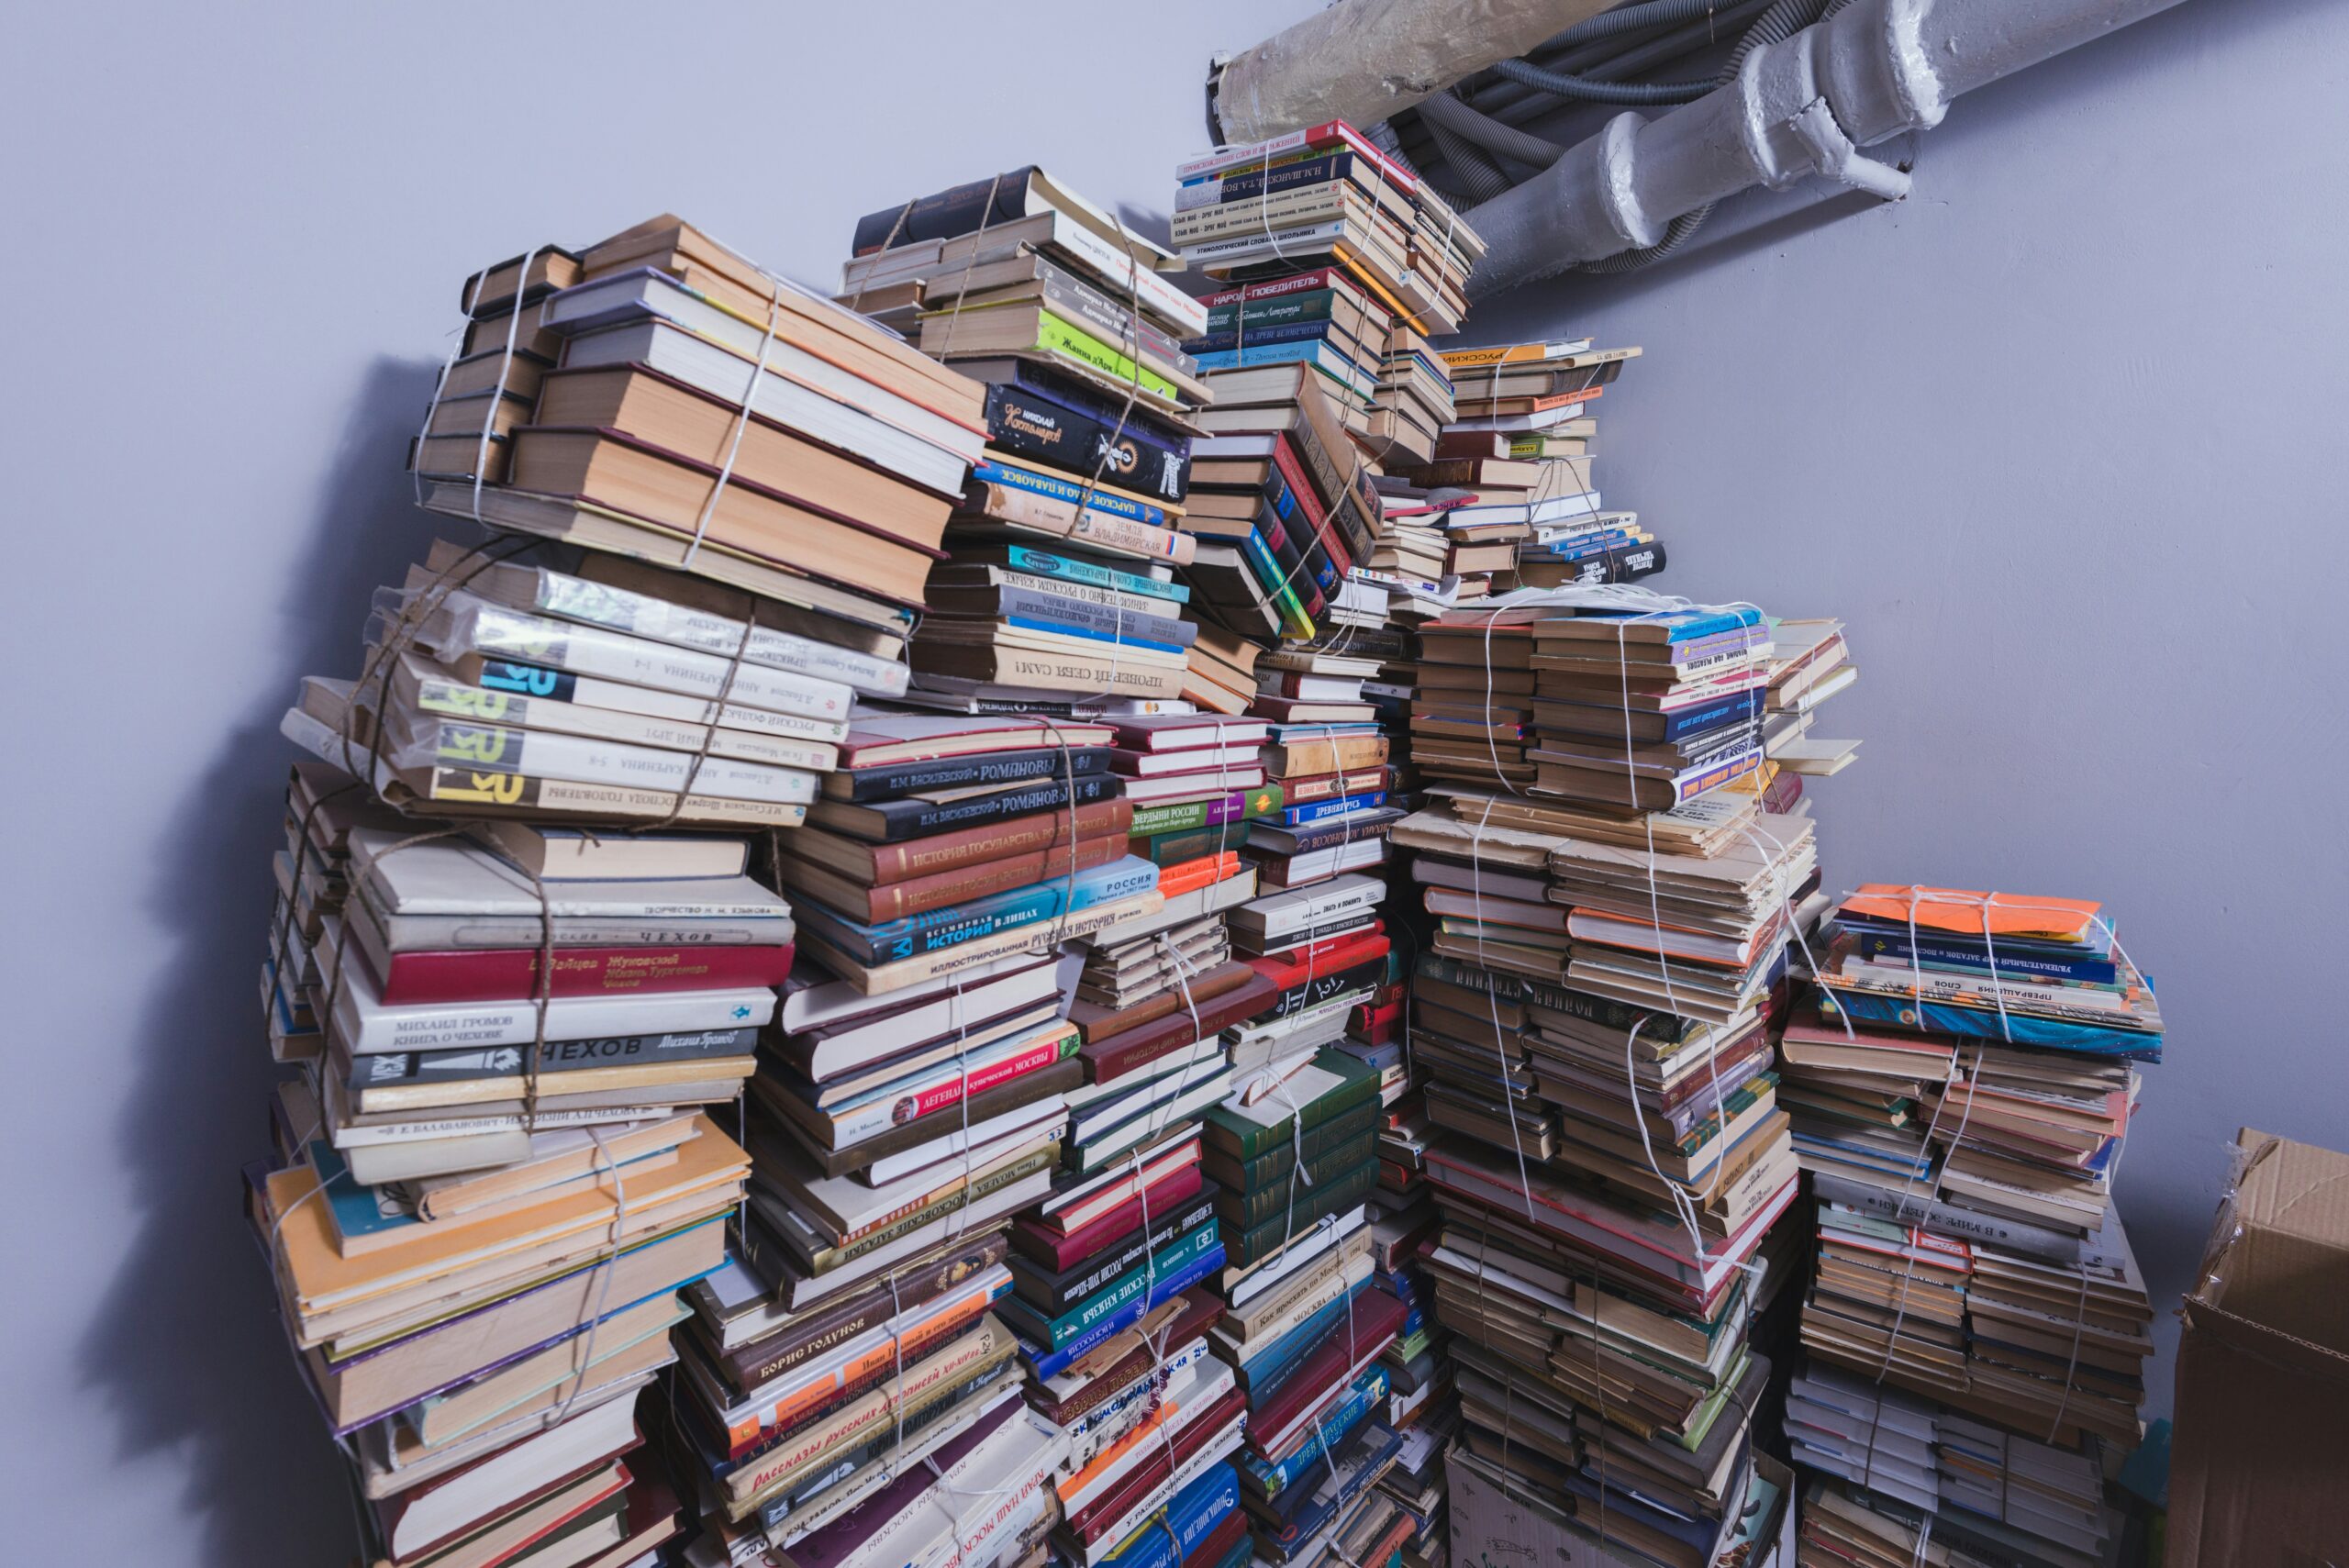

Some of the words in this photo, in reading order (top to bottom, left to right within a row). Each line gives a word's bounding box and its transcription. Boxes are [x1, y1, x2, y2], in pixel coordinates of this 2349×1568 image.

[1277, 228, 1315, 240] ШКОЛЬНИКА
[1061, 336, 1092, 361] Жанна
[1001, 468, 1056, 493] ПАВЛОВСК
[1093, 494, 1135, 514] ЦАРСКОЕ
[1115, 519, 1142, 536] ЗЕМЛЯ
[1094, 527, 1161, 552] ВЛАДИМИРСКАЯ
[1015, 661, 1052, 675] САМ!
[1687, 656, 1712, 671] PLEASURE
[1713, 653, 1723, 663] FOR
[1056, 665, 1091, 680] СЕБЯ
[979, 759, 1055, 781] РОМАНОВЫ
[1001, 787, 1068, 812] РОМАНОВЫ
[1171, 805, 1199, 818] РОССИИ
[913, 844, 966, 867] ИСТОРИЯ
[967, 829, 1040, 855] ГОСУДАРСТВА
[1107, 873, 1151, 892] РОССИЯ
[926, 916, 992, 938] ВСЕМИРНАЯ
[1002, 907, 1037, 925] ЛИЦАХ
[1074, 912, 1115, 935] ИСТОРИЯ
[640, 931, 713, 941] ЧЕХОВ
[927, 922, 992, 950] ИСТОРИЯ
[607, 953, 679, 968] Жуковский
[930, 940, 1028, 974] ИЛЛЮСТРИРОВАННАЯ
[1944, 949, 1980, 962] ЗАГАДОК
[2000, 956, 2071, 973] УВЛЕКАТЕЛЬНЫЙ
[604, 966, 646, 979] Жизнь
[649, 963, 708, 977] Тургенева
[1933, 980, 1961, 989] СЛОВ
[395, 1018, 457, 1031] МИХАИЛ
[462, 1016, 513, 1028] ГРОМОВ
[393, 1034, 438, 1045] КНИГА
[441, 1032, 451, 1042] О
[453, 1029, 504, 1040] ЧЕХОВЕ
[657, 1031, 700, 1048] Михаил
[1013, 1050, 1049, 1073] МОСКВЫ
[1017, 1158, 1036, 1175] Нина
[975, 1167, 1015, 1195] МОЛЕВА
[1944, 1215, 1981, 1233] МИРЕ
[1984, 1225, 1994, 1237] В
[843, 1227, 894, 1260] ЗАГАДКИ
[1099, 1256, 1121, 1284] РОССИИ
[1082, 1290, 1117, 1326] КНЯЗЬЯ
[1259, 1308, 1274, 1329] Как
[1275, 1284, 1308, 1318] проехать
[1308, 1275, 1318, 1289] по
[761, 1347, 804, 1378] БОРИС
[807, 1317, 863, 1356] ГОДУНОВ
[862, 1350, 885, 1371] Иван
[933, 1318, 946, 1332] его
[948, 1306, 971, 1323] жены
[1066, 1332, 1095, 1357] РОССИЯ
[790, 1393, 832, 1428] Андреев
[778, 1412, 819, 1444] Андреев
[1017, 1468, 1048, 1499] КРАЙ
[992, 1492, 1023, 1523] НАШ
[865, 1506, 915, 1554] МОСКВЫ
